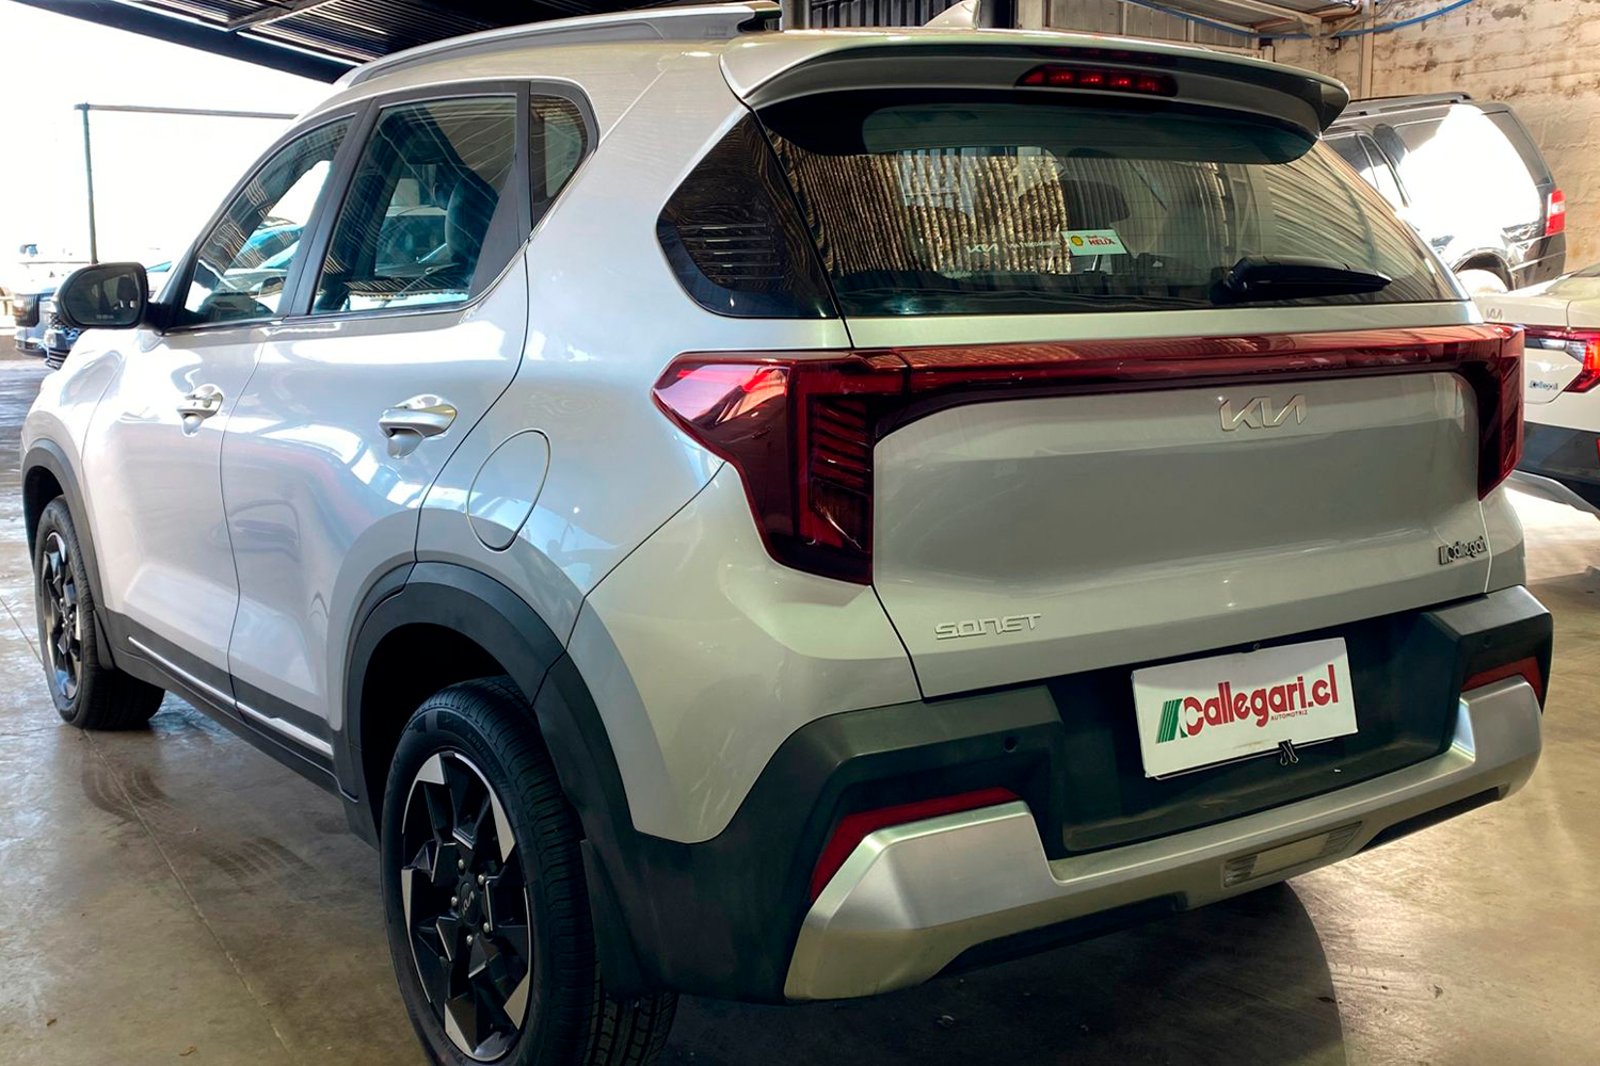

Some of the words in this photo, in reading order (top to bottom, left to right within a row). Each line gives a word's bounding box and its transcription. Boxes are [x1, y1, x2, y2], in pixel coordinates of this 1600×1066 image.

[1219, 393, 1307, 432] KIA
[934, 613, 1042, 640] SONET
[1182, 664, 1339, 736] Callegari.cl
[1270, 710, 1308, 721] AUTOMOTRIZ
